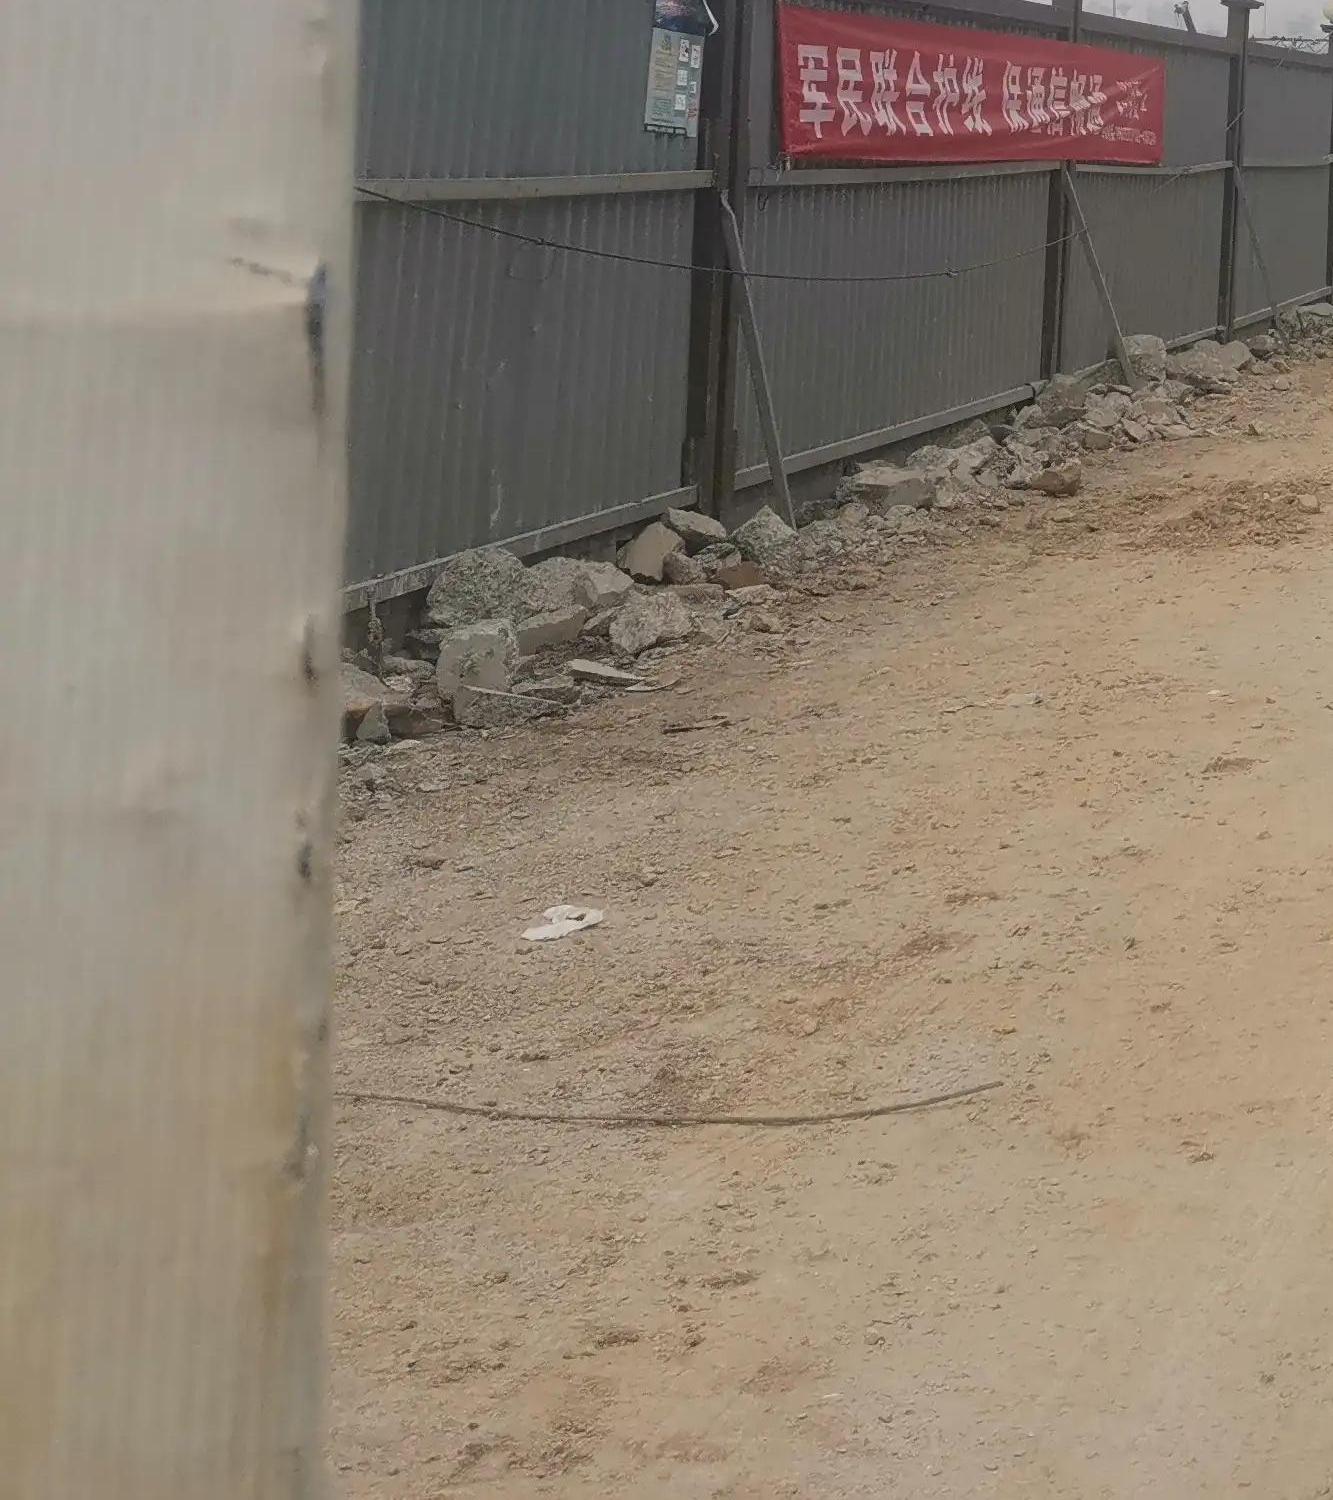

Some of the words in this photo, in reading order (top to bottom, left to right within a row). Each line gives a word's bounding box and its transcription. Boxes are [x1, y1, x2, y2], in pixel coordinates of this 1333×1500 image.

[798, 44, 992, 139] 军民联合护线
